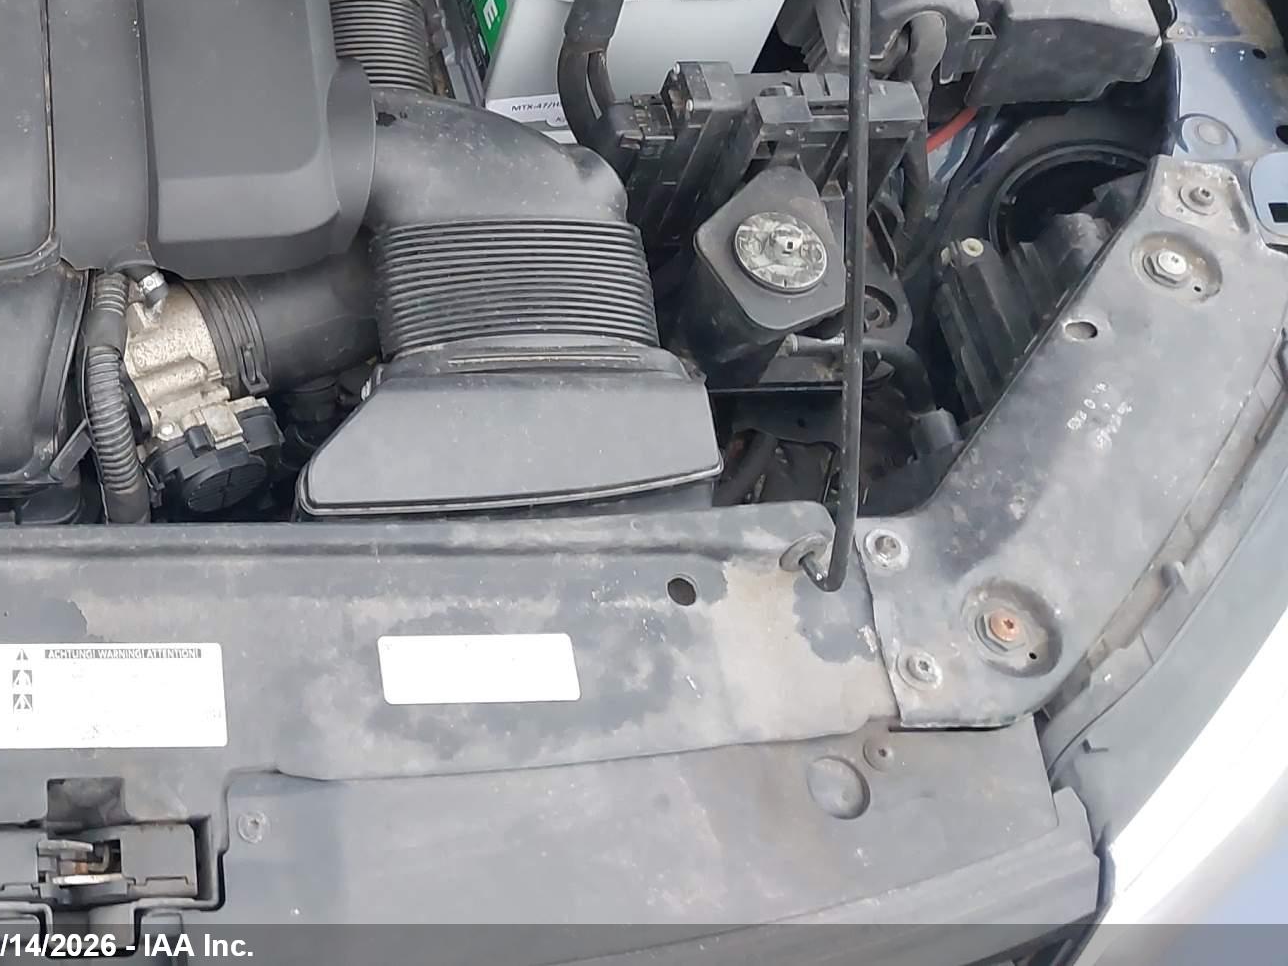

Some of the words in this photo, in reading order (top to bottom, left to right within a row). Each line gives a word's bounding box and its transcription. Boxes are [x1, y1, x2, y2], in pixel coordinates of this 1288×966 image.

[511, 101, 561, 112] MTX-47/H
[47, 648, 95, 659] ACHTUNG!
[97, 648, 144, 659] WARNING!
[146, 648, 199, 659] ATTENTION!
